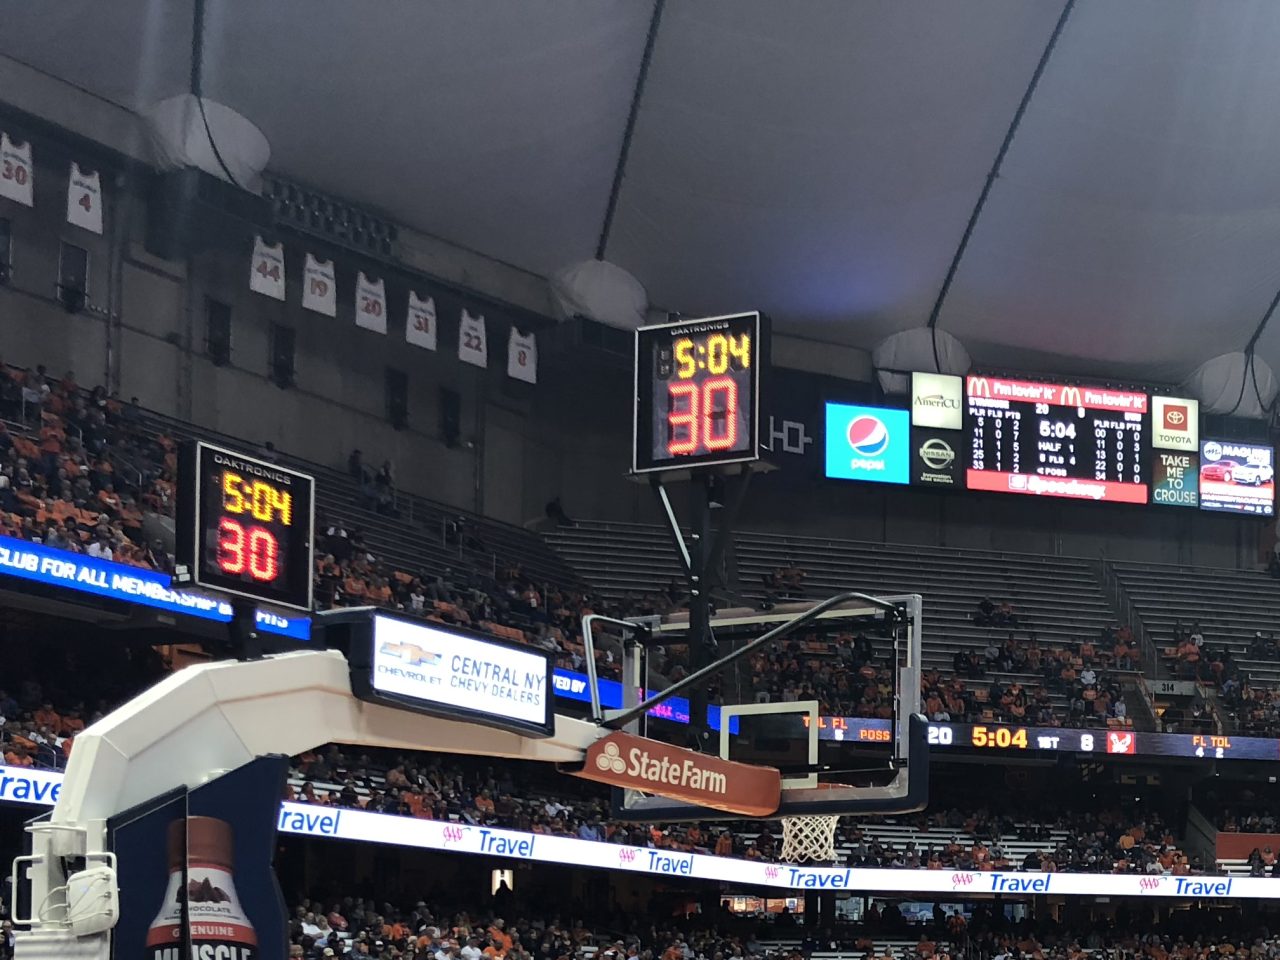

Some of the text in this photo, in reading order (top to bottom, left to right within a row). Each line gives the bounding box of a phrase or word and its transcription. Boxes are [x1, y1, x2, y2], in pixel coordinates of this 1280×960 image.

[2, 160, 28, 185] 30
[79, 193, 91, 213] 4
[256, 261, 280, 282] 44
[413, 314, 429, 334] 31
[671, 321, 729, 336] DAKTRONICS
[464, 331, 482, 352] 22
[674, 333, 750, 380] 5:04
[914, 395, 960, 410] AmeriCU
[668, 377, 738, 455] 30
[969, 407, 985, 416] PLR
[1039, 421, 1076, 439] 5:04
[1094, 419, 1109, 429] PLR
[974, 428, 983, 438] 11
[1095, 429, 1106, 438] 00
[1159, 434, 1192, 444] TOYOTA
[973, 439, 983, 448] 21
[1038, 441, 1061, 452] HALF
[1096, 440, 1106, 449] 11
[923, 449, 952, 459] NISSAN
[973, 450, 984, 459] 25
[1096, 450, 1106, 460] 13
[1160, 455, 1190, 467] TAKE
[214, 454, 291, 485] DAKTRONICS
[851, 459, 885, 472] pepsi
[973, 460, 984, 470] 33
[1095, 461, 1106, 471] 22
[1166, 467, 1184, 478] ME
[1167, 478, 1183, 489] TO
[223, 470, 292, 526] 5:04
[1154, 489, 1197, 503] CROUSE
[217, 517, 278, 581] 30
[41, 558, 76, 580] FOR
[77, 567, 109, 588] ALL
[378, 664, 442, 686] CHEVROLET
[451, 655, 519, 686] CENTRAL
[524, 668, 546, 690] NY
[450, 675, 541, 706] CHEVY DEALERS
[1162, 683, 1175, 692] 314
[832, 717, 847, 729] FL
[860, 730, 890, 740] POSS
[928, 726, 953, 744] 20
[972, 726, 1027, 748] 5:04
[1193, 736, 1231, 747] FL TOL
[1080, 734, 1094, 751] 8
[1195, 747, 1224, 758] 4 2
[0, 769, 61, 802] rave
[279, 803, 1233, 897] ravel Travel Travel Travel Travel Travel
